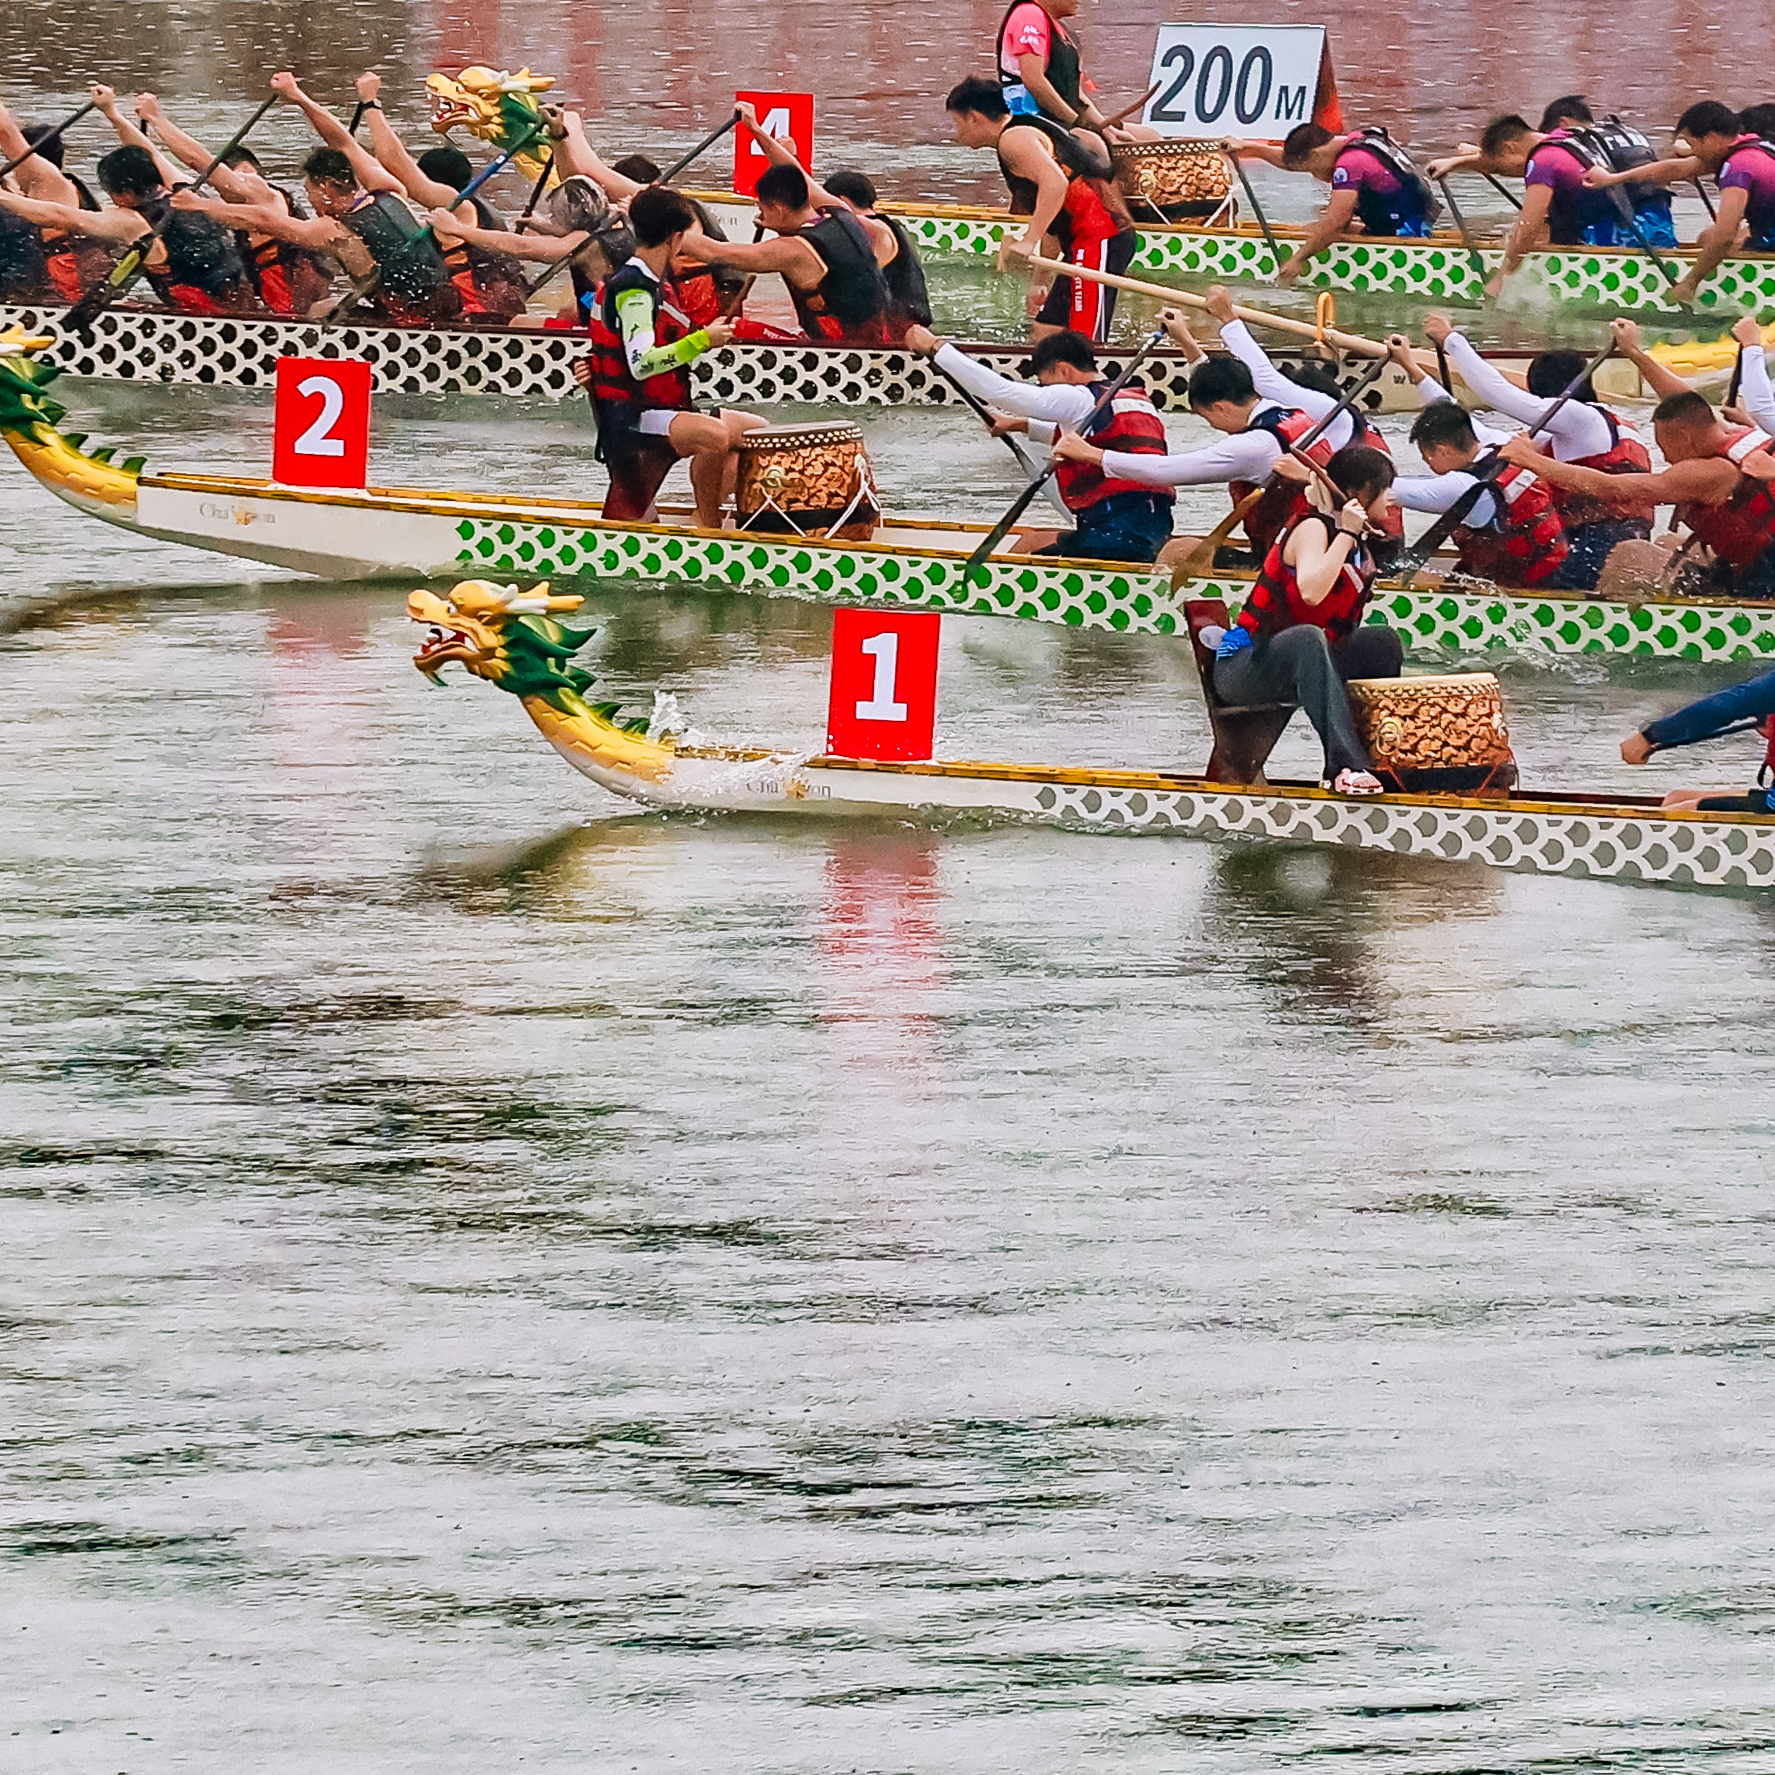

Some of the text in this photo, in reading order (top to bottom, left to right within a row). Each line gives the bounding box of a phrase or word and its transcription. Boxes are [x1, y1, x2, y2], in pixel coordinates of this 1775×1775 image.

[1149, 43, 1307, 125] 200M
[293, 375, 345, 457] 2
[855, 631, 909, 723] 1
